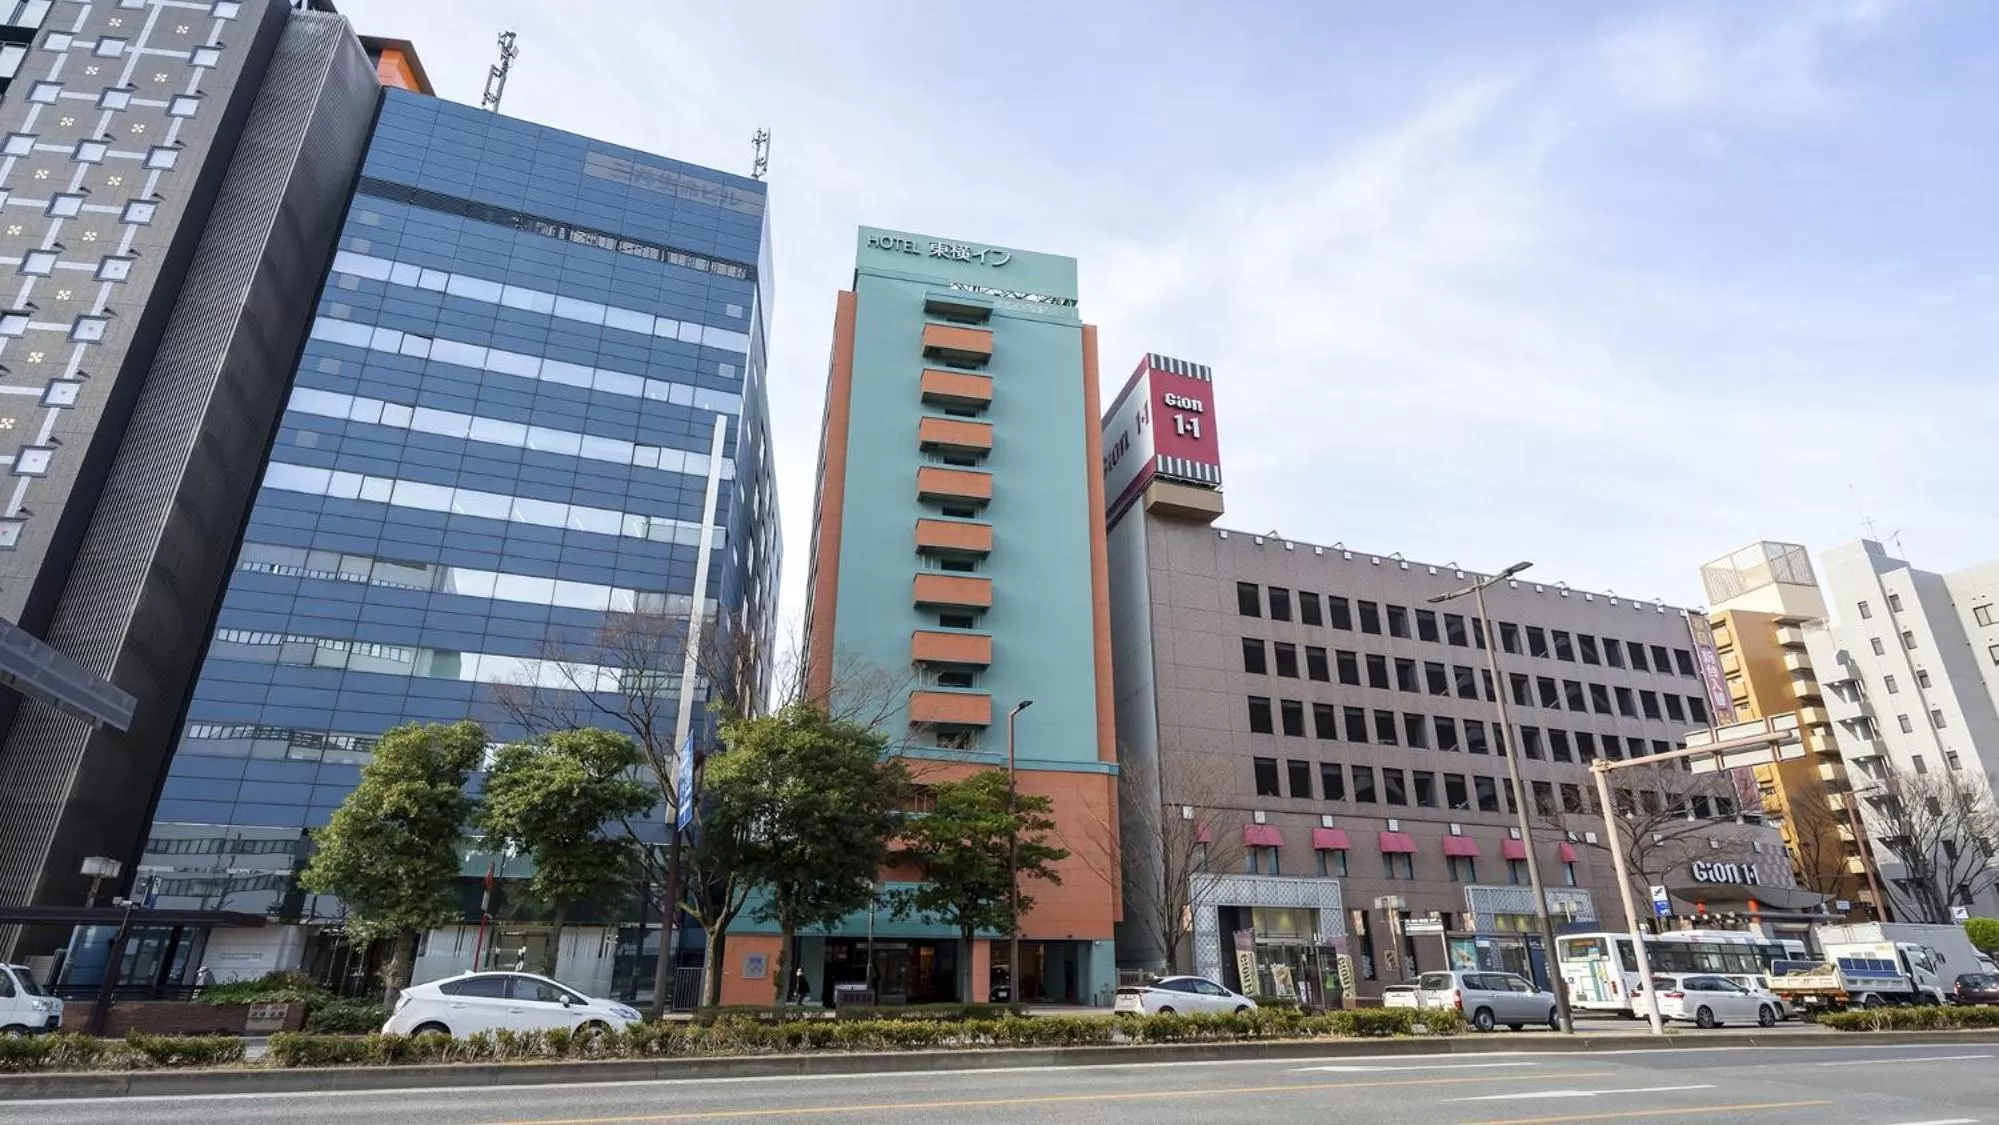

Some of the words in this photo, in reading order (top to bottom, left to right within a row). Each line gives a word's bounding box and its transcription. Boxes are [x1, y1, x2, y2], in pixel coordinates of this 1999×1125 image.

[867, 235, 920, 255] HOTEL
[929, 241, 1012, 267] 東横イン
